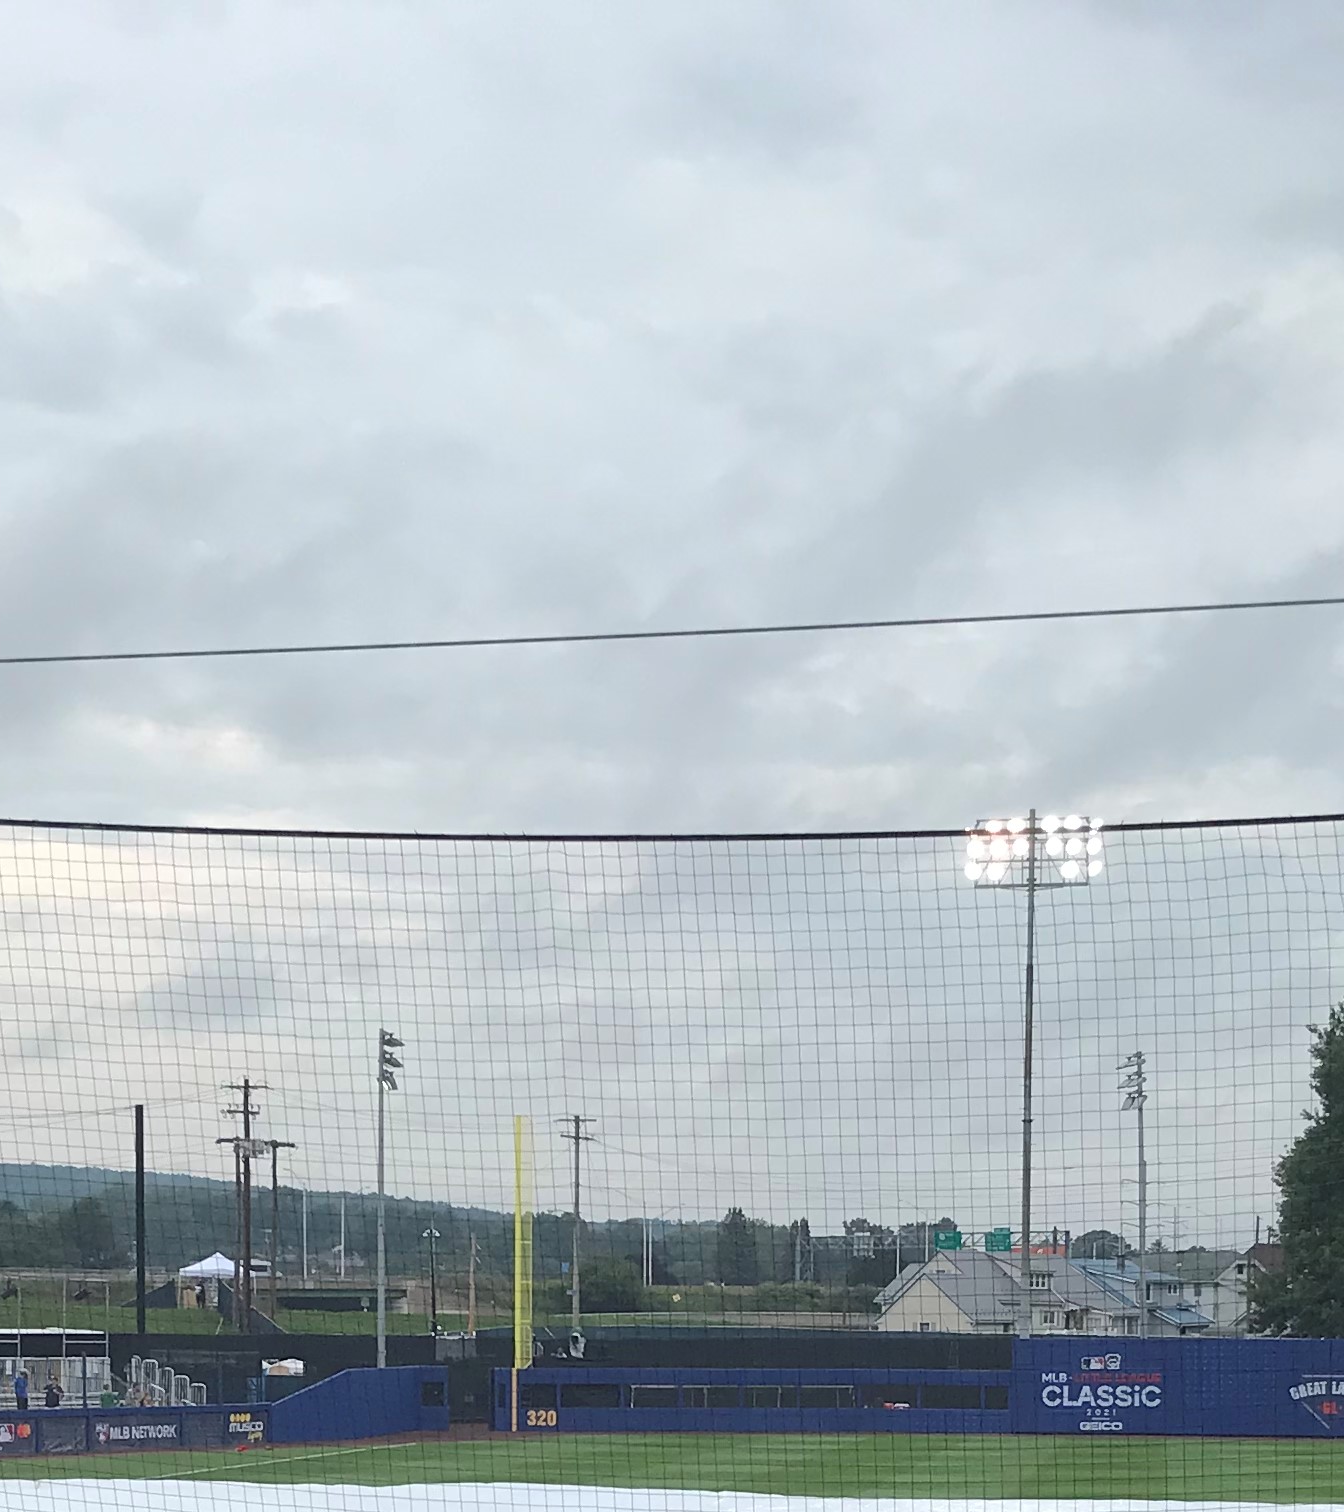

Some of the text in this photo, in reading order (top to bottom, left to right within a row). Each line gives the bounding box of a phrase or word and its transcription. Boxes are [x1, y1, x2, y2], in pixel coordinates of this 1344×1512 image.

[1041, 1372, 1068, 1383] MLB
[1289, 1381, 1328, 1400] GREAT
[526, 1410, 557, 1426] 320
[1086, 1408, 1117, 1416] 2021
[109, 1426, 130, 1440] MLB
[131, 1424, 177, 1439] NETWORK
[1079, 1421, 1123, 1431] GEICO
